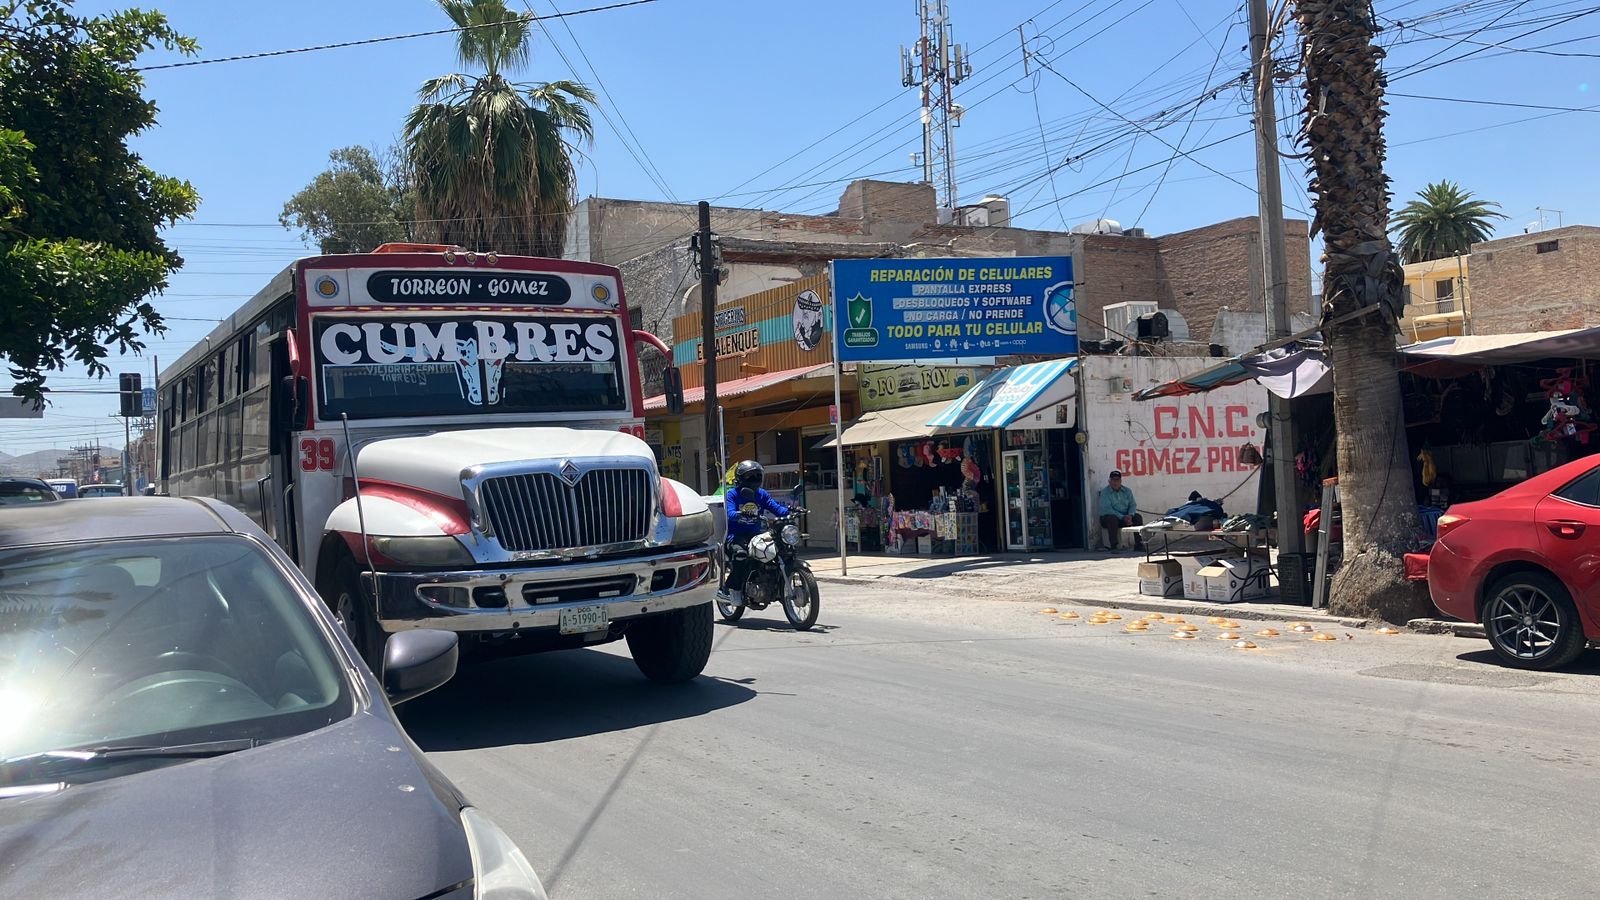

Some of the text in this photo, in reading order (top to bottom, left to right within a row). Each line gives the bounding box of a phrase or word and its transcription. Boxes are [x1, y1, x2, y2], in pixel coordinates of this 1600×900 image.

[870, 266, 1053, 282] REPARACIÓN DE CELULARES
[391, 278, 549, 297] TORREON GOMEZ
[918, 283, 1012, 295] PANTALLA EXPRESS
[898, 295, 1033, 308] DESBLOQUEOS Y SOFTWARE
[909, 311, 923, 321] NO
[926, 310, 959, 321] CARGA
[968, 310, 983, 320] NO
[985, 308, 1024, 319] PRENDE
[887, 321, 1043, 338] TODO PARA TU CELULAR
[320, 320, 615, 365] CUMBRES
[714, 329, 758, 356] ALENQUE
[905, 342, 928, 350] SAMSUNG
[1153, 405, 1256, 439] C.N.C.
[299, 437, 336, 472] 39
[1116, 440, 1201, 477] GÓMEZ
